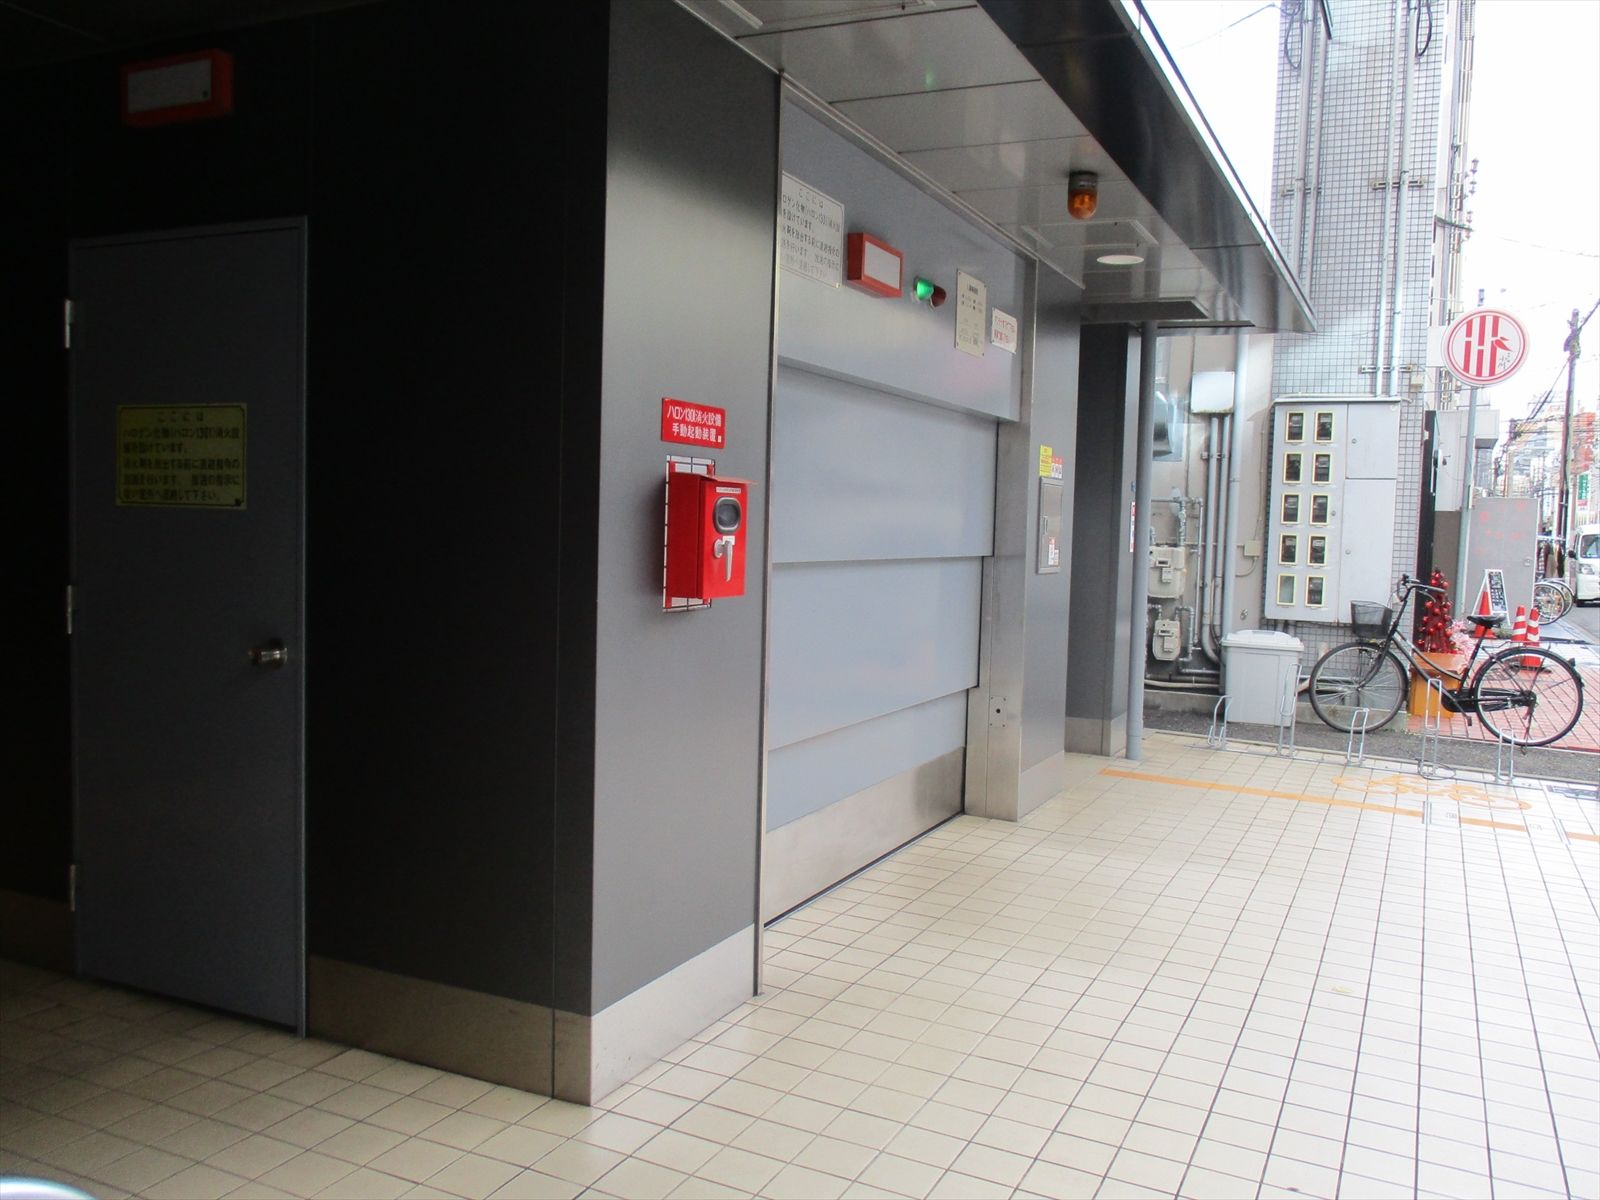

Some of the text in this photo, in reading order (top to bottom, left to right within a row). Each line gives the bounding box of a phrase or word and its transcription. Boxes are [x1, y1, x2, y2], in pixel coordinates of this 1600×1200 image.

[672, 422, 717, 443] 手動起動装置
